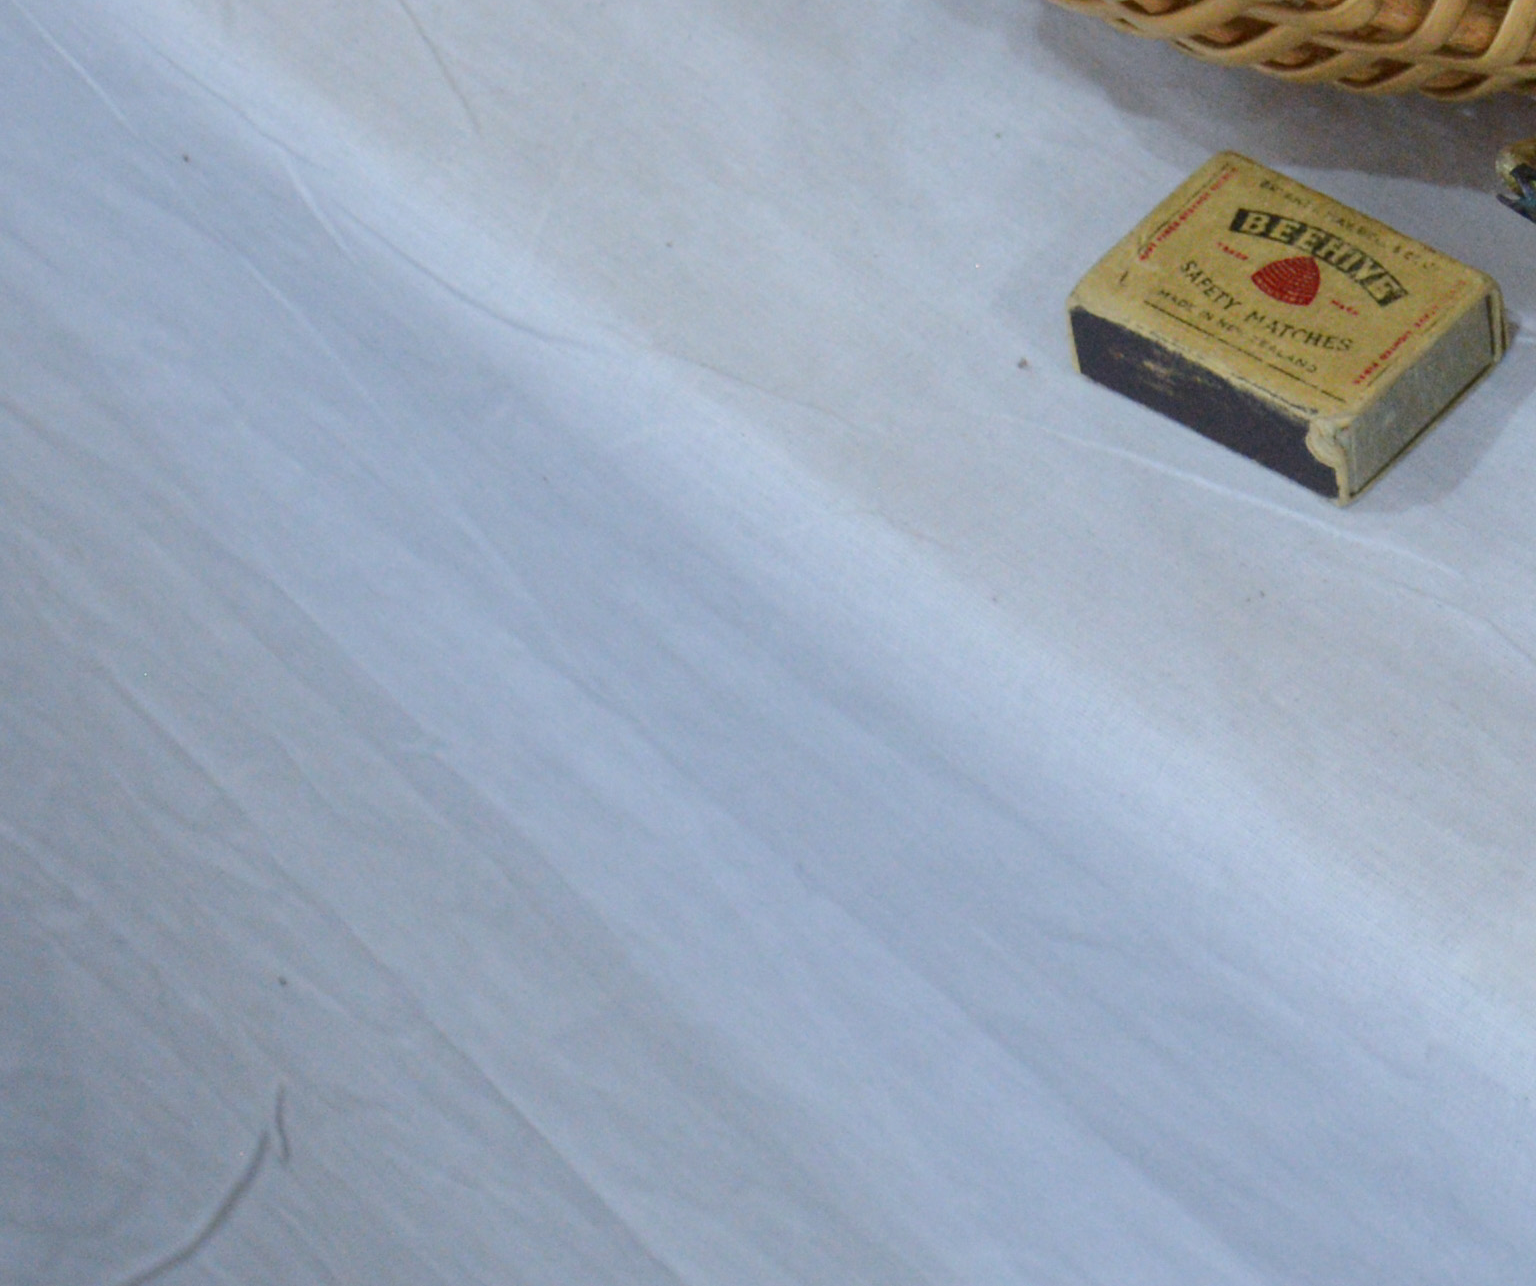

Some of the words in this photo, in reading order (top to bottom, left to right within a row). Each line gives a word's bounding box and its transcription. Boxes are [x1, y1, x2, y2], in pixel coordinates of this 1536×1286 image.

[1241, 212, 1399, 304] BEEHIVE
[1180, 259, 1242, 310] SAFETY
[1244, 310, 1354, 352] MATCHES
